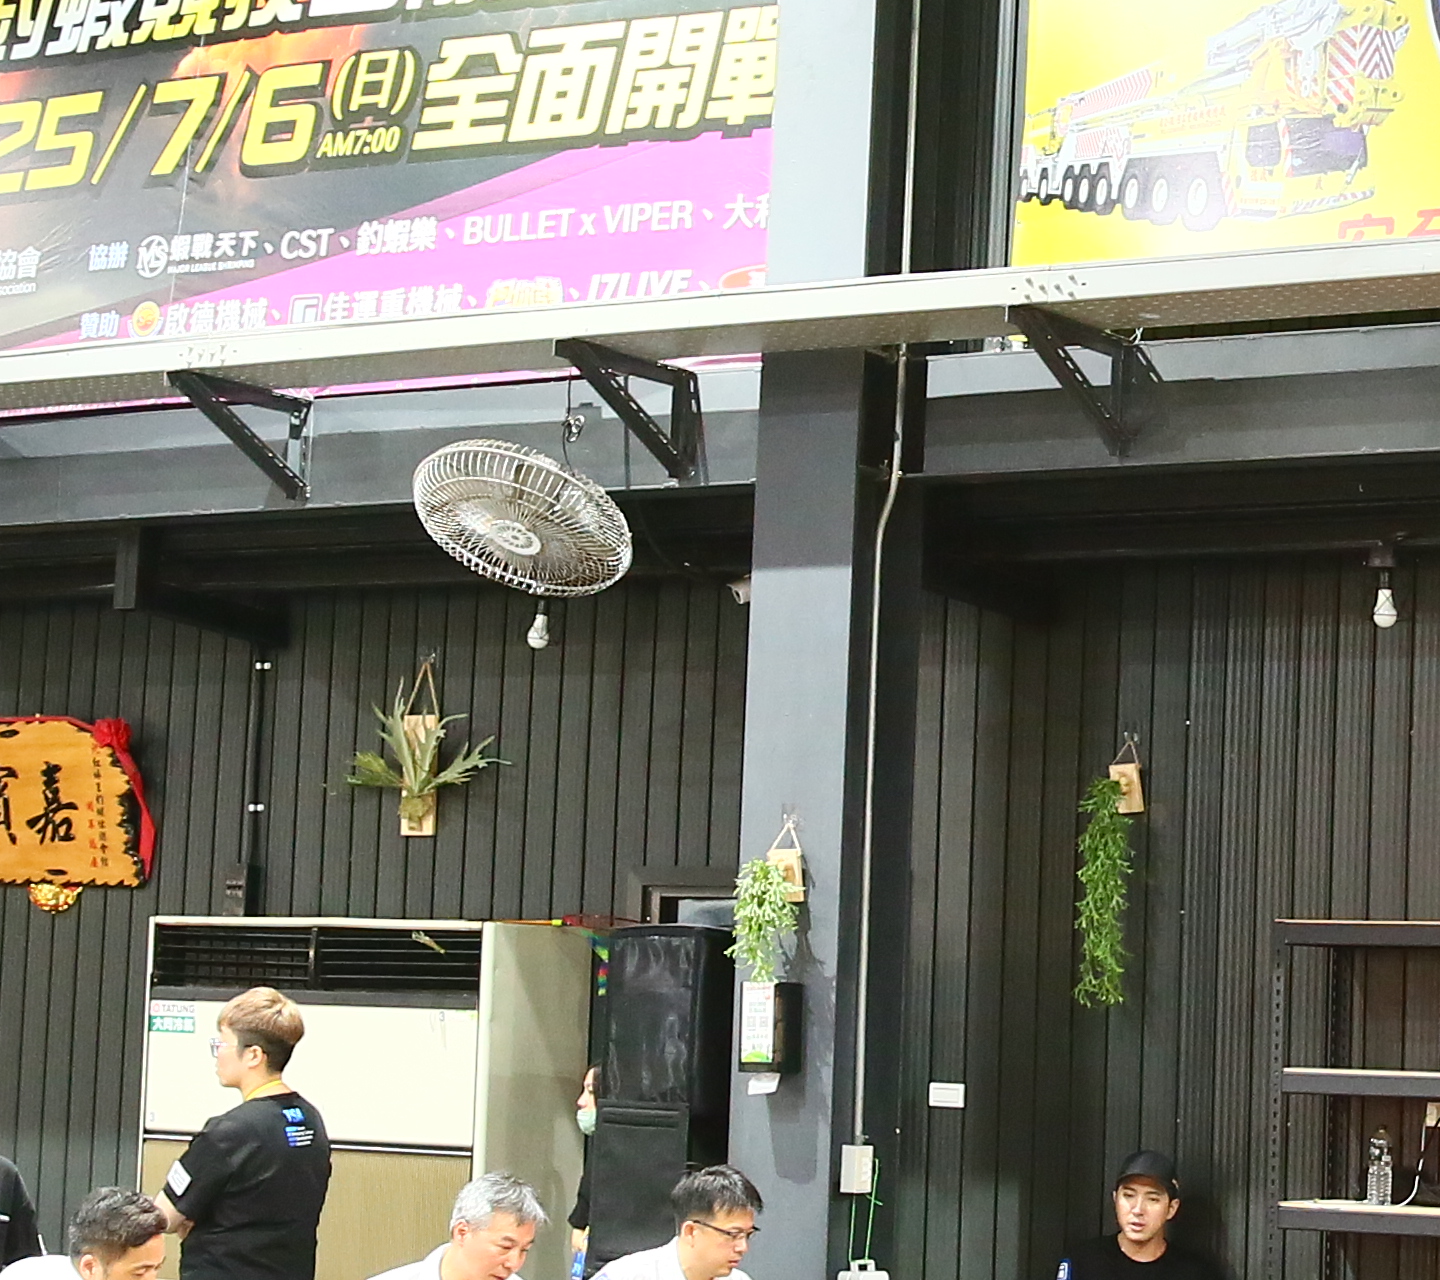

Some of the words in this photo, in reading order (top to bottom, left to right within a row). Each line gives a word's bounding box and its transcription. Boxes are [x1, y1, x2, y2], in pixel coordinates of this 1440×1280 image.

[315, 126, 401, 160] AM7:00
[463, 207, 576, 246] BULLET
[578, 212, 597, 237] x
[161, 1003, 195, 1014] TATUNG
[151, 1016, 194, 1032] 大同冷氣
